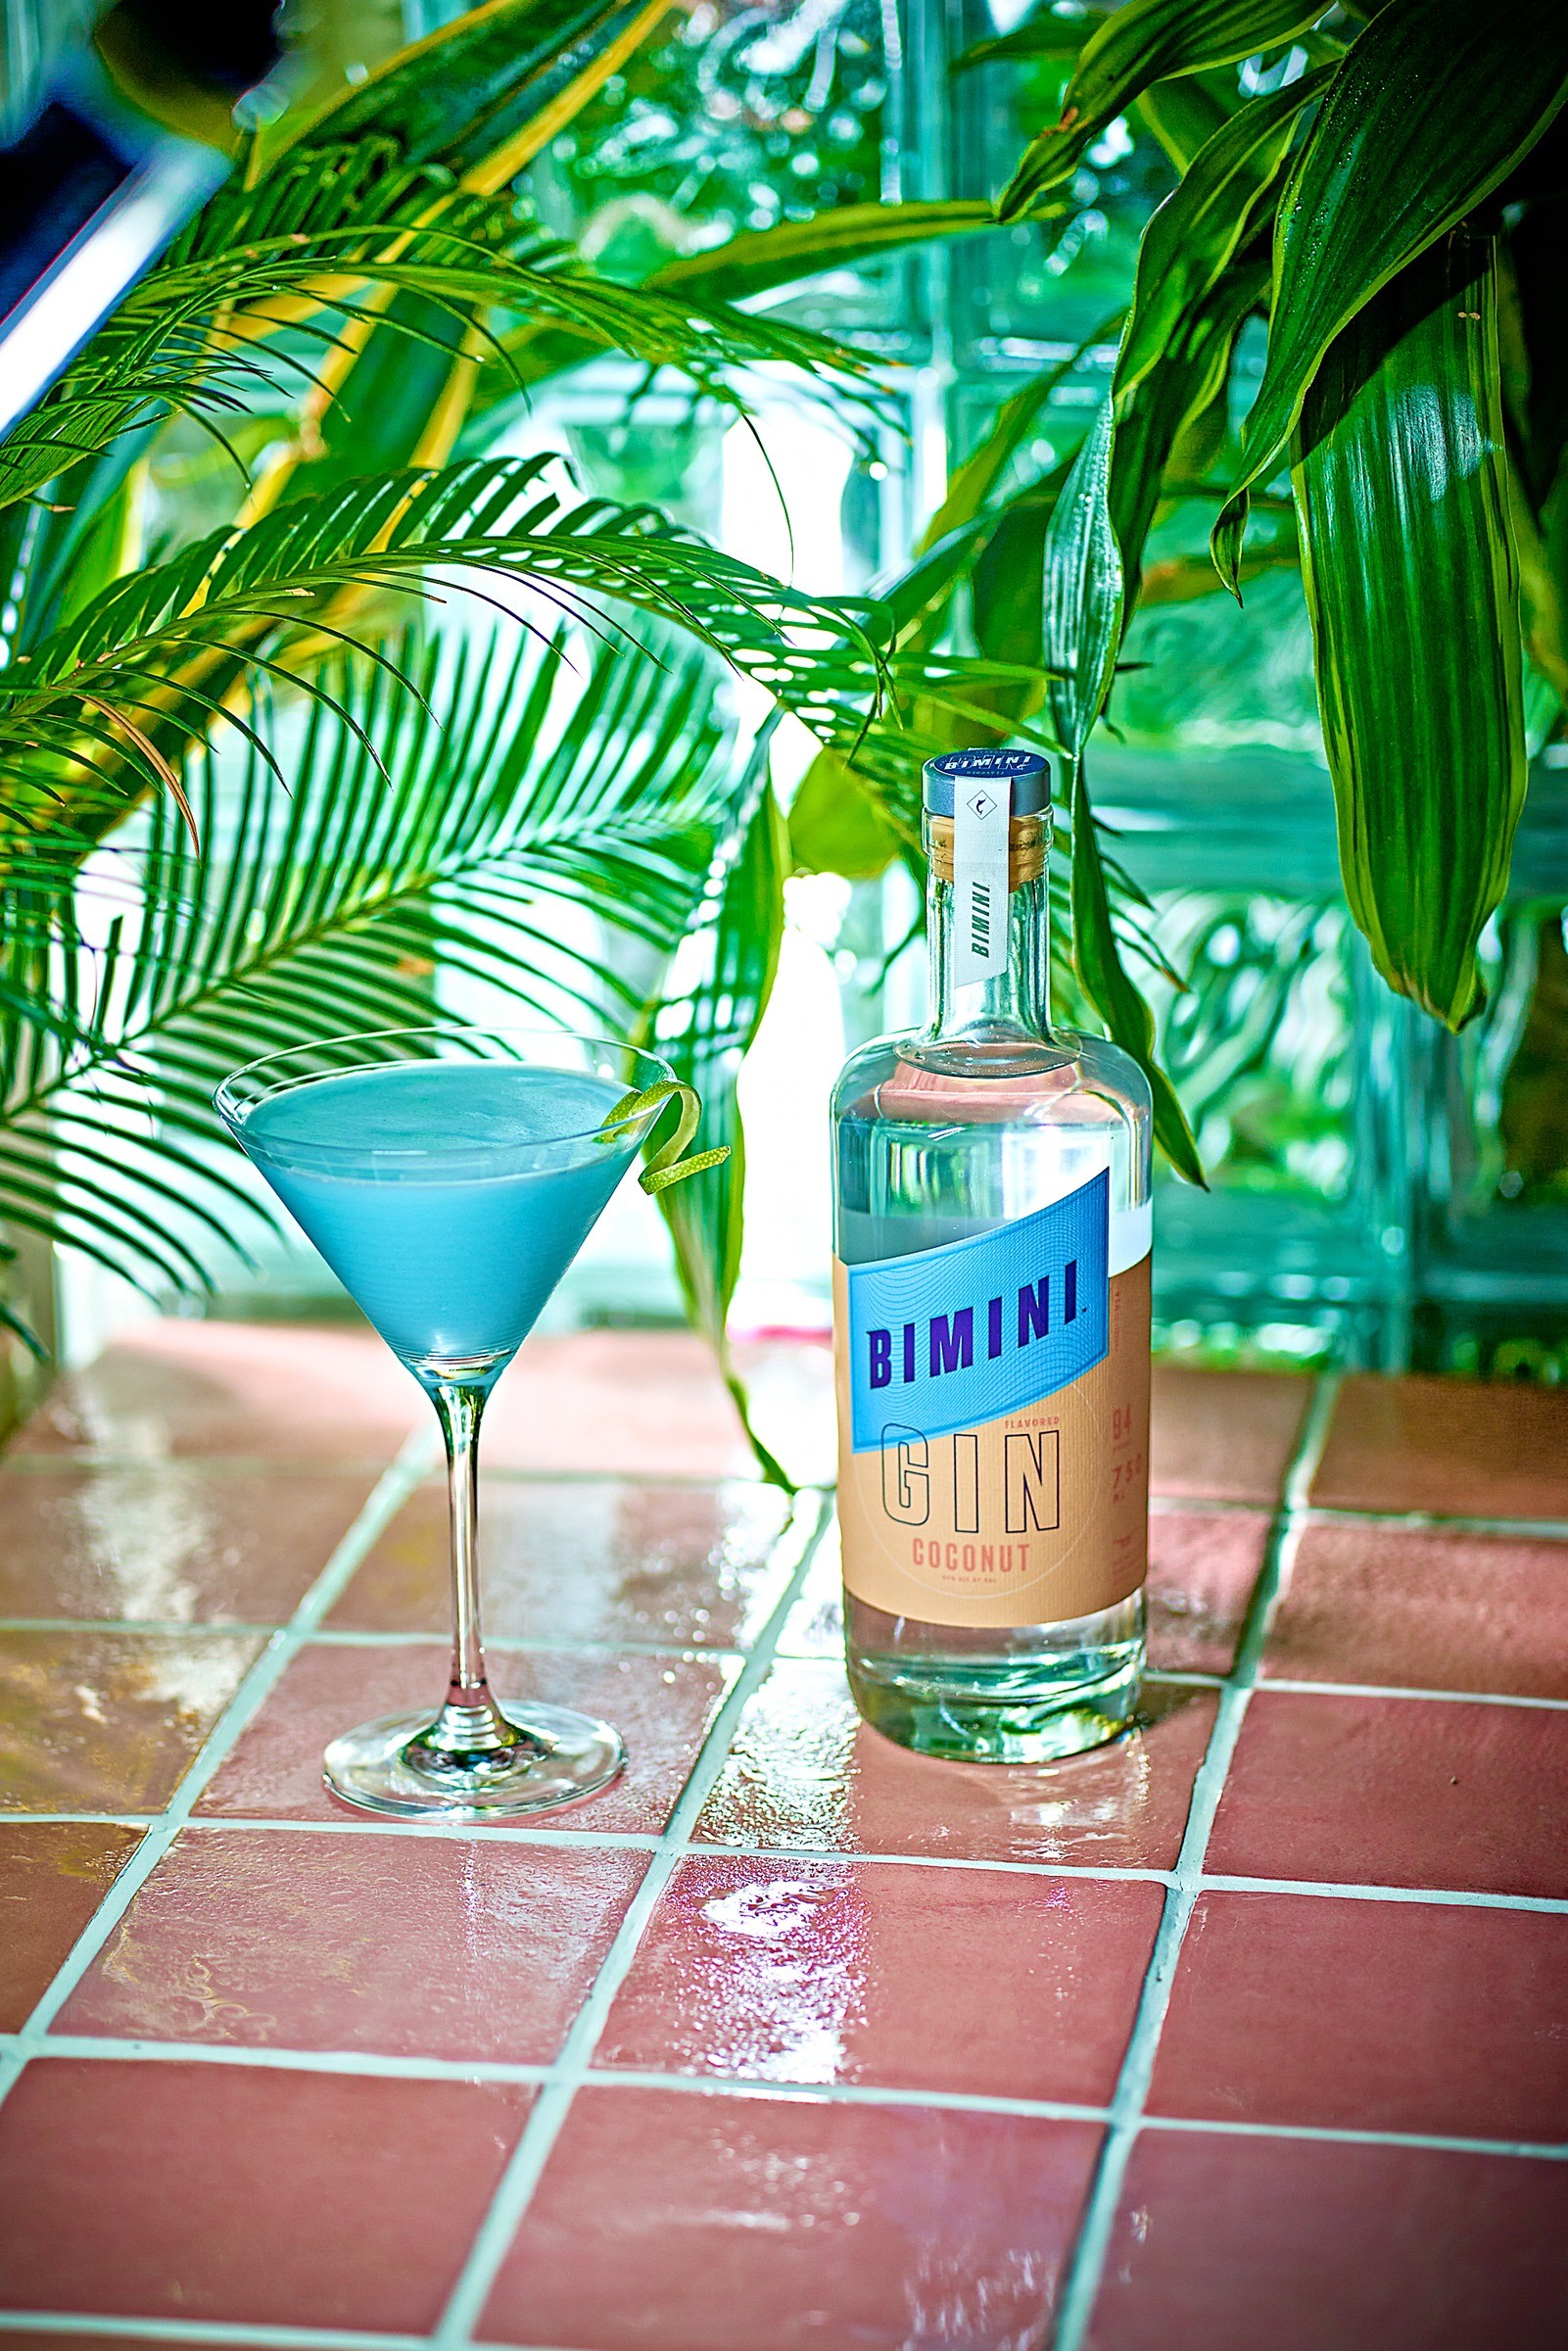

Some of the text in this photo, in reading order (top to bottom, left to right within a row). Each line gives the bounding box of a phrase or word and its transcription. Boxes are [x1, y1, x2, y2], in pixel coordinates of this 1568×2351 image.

[944, 755, 1031, 770] BIMINI
[972, 882, 990, 959] BIMINI
[866, 1259, 1077, 1389] BIMINI
[1004, 1416, 1060, 1429] FLAVORED
[880, 1422, 1060, 1534] GIN
[1112, 1453, 1142, 1489] 750
[913, 1538, 1030, 1572] COCONUT
